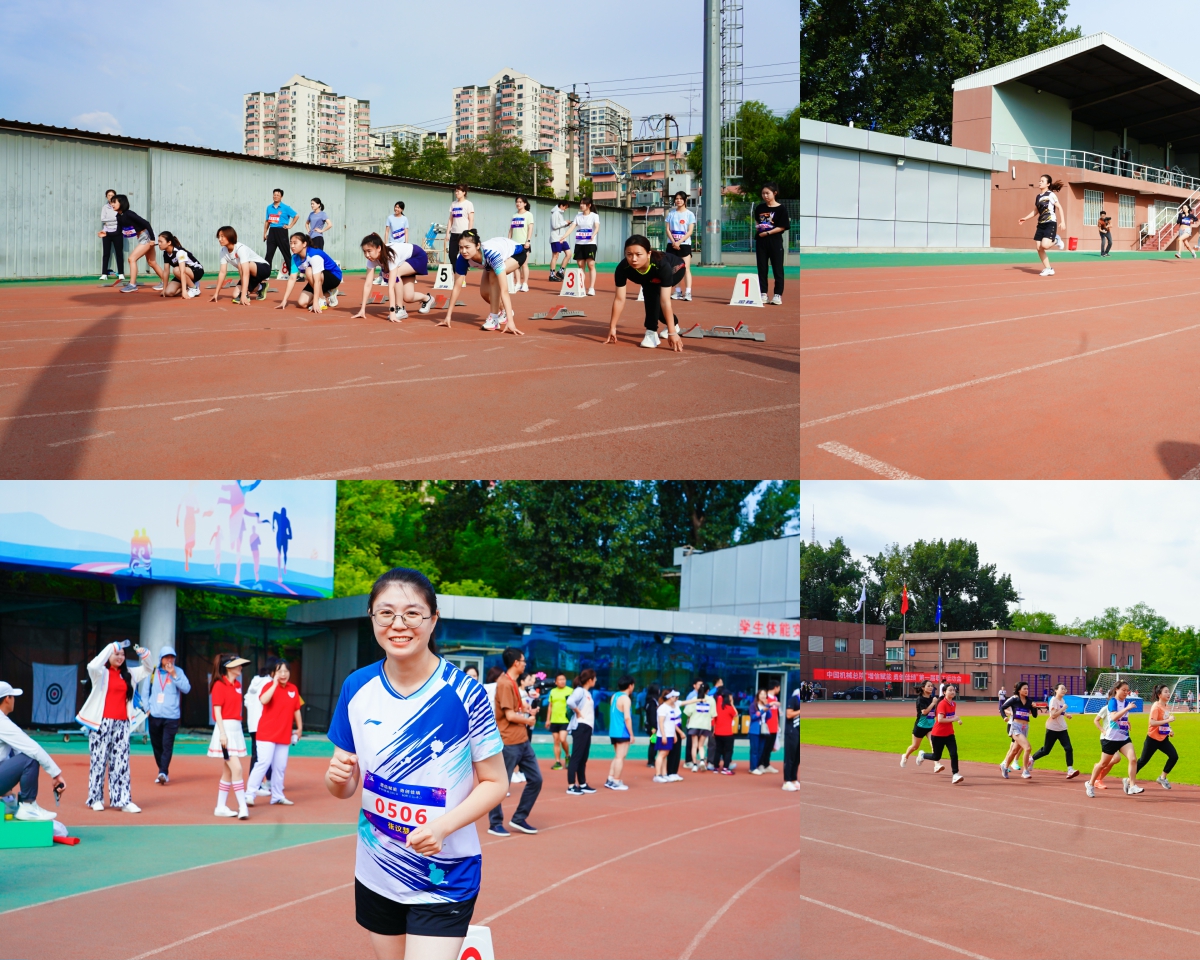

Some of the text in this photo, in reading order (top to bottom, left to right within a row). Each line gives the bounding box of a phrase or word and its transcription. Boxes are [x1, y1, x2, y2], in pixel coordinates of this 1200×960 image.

[440, 267, 448, 282] 5
[566, 272, 575, 288] 3
[741, 278, 750, 297] 1
[375, 797, 427, 825] 0506
